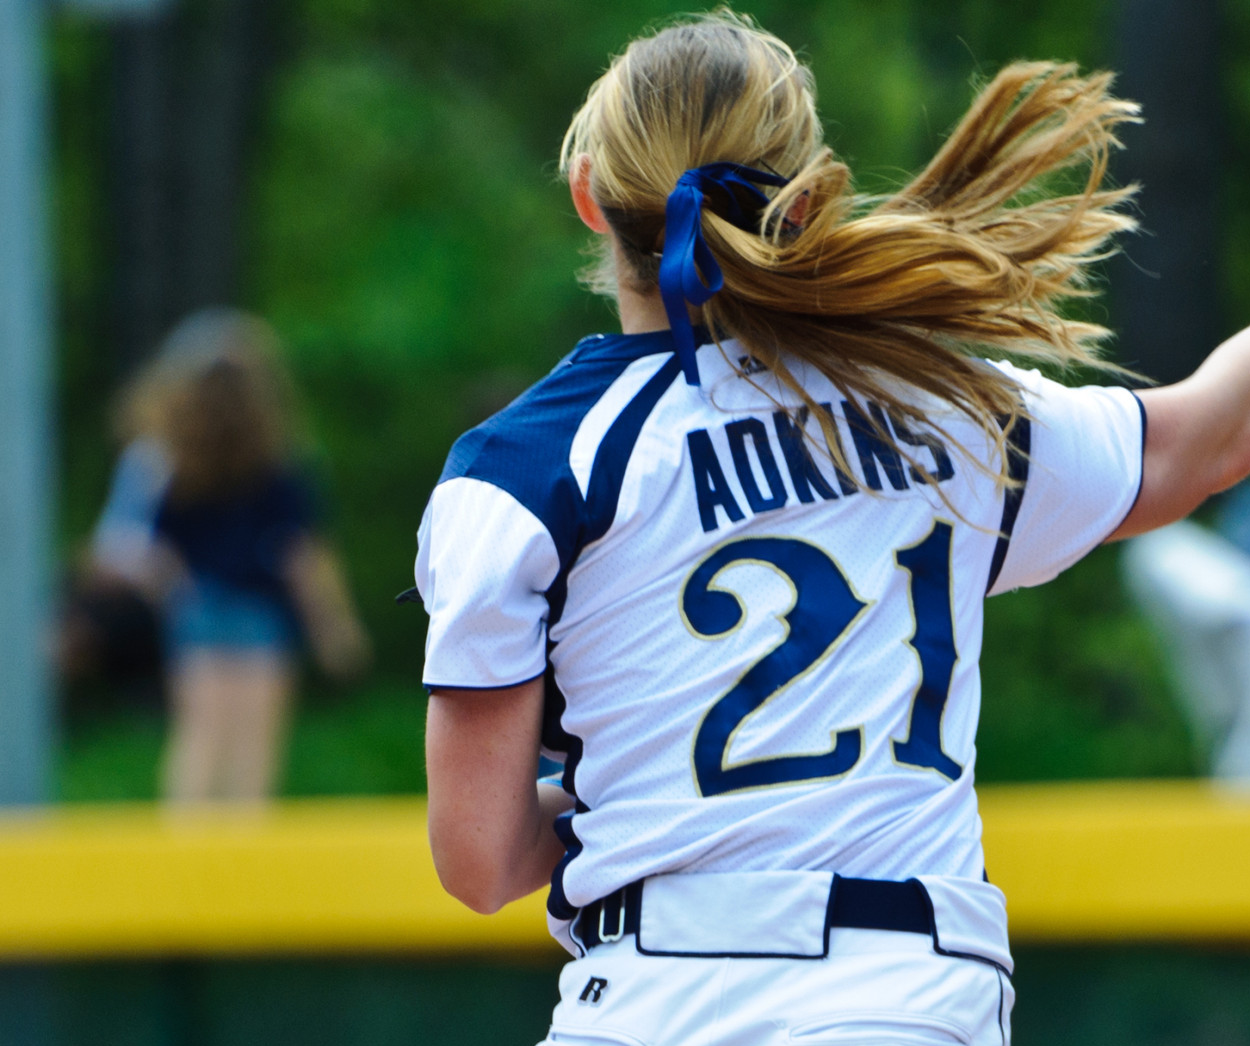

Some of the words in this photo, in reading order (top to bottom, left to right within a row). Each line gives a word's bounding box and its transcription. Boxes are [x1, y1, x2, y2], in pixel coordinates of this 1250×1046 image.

[686, 400, 955, 533] ADKINS
[679, 517, 965, 798] 21
[579, 975, 608, 1003] R
